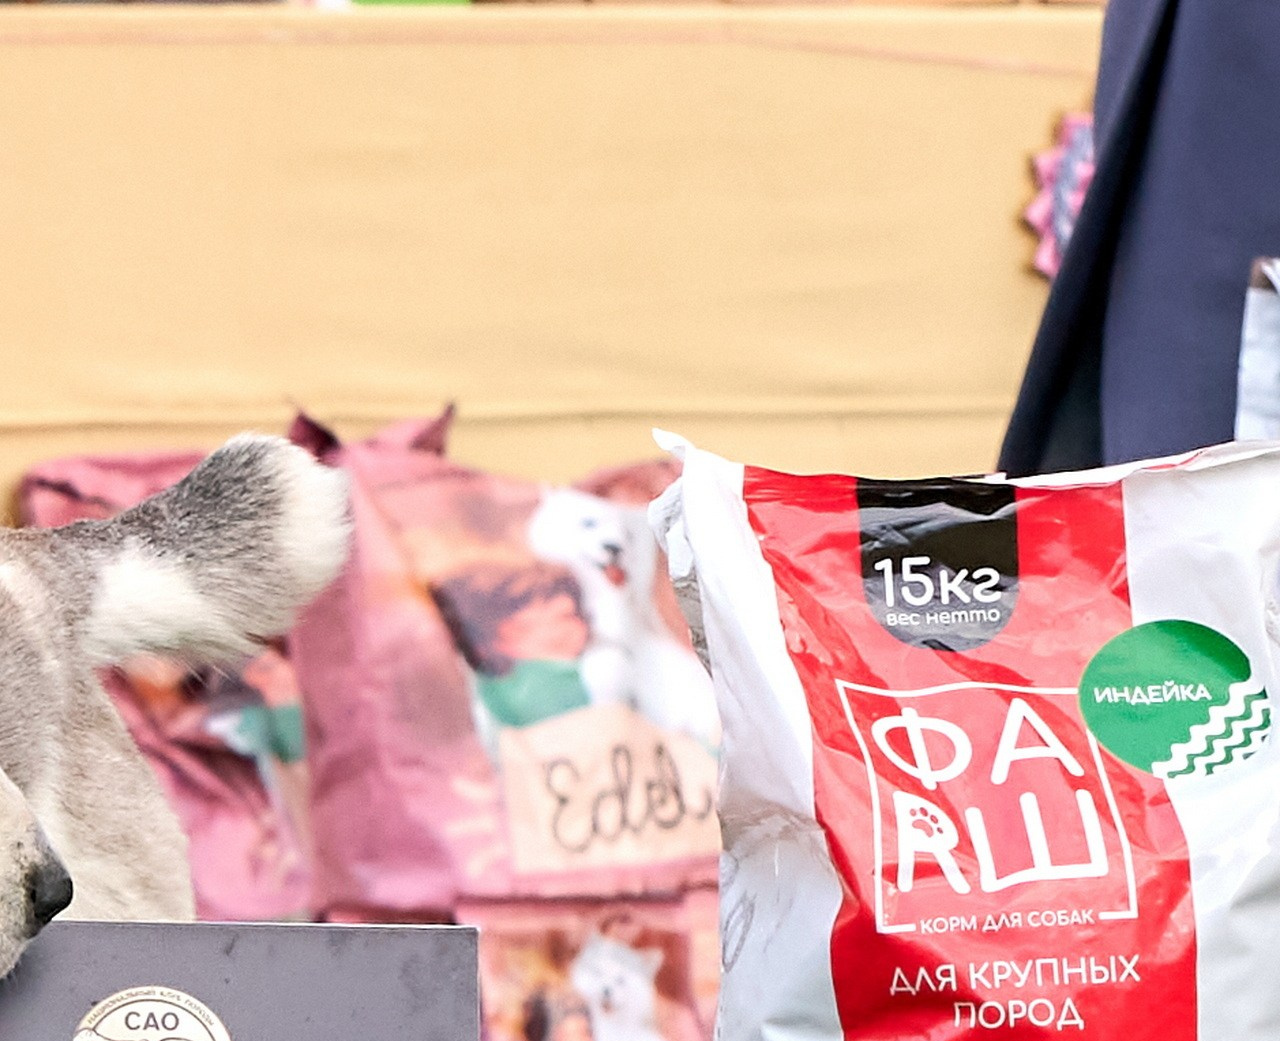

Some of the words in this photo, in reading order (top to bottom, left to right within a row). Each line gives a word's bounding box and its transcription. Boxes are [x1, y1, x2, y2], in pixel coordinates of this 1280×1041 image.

[875, 557, 1002, 609] 15кг
[886, 611, 920, 626] вес
[926, 609, 1000, 625] нетто
[1093, 680, 1212, 705] ИНДЕЙКА
[920, 914, 977, 934] КОРМ
[982, 912, 1023, 932] ДЛЯ
[1027, 909, 1095, 929] СОБАК
[890, 963, 957, 996] ДЛЯ
[969, 955, 1140, 990] КРУПНЫХ
[124, 1011, 180, 1031] САО
[953, 998, 1084, 1030] ПОРОД
